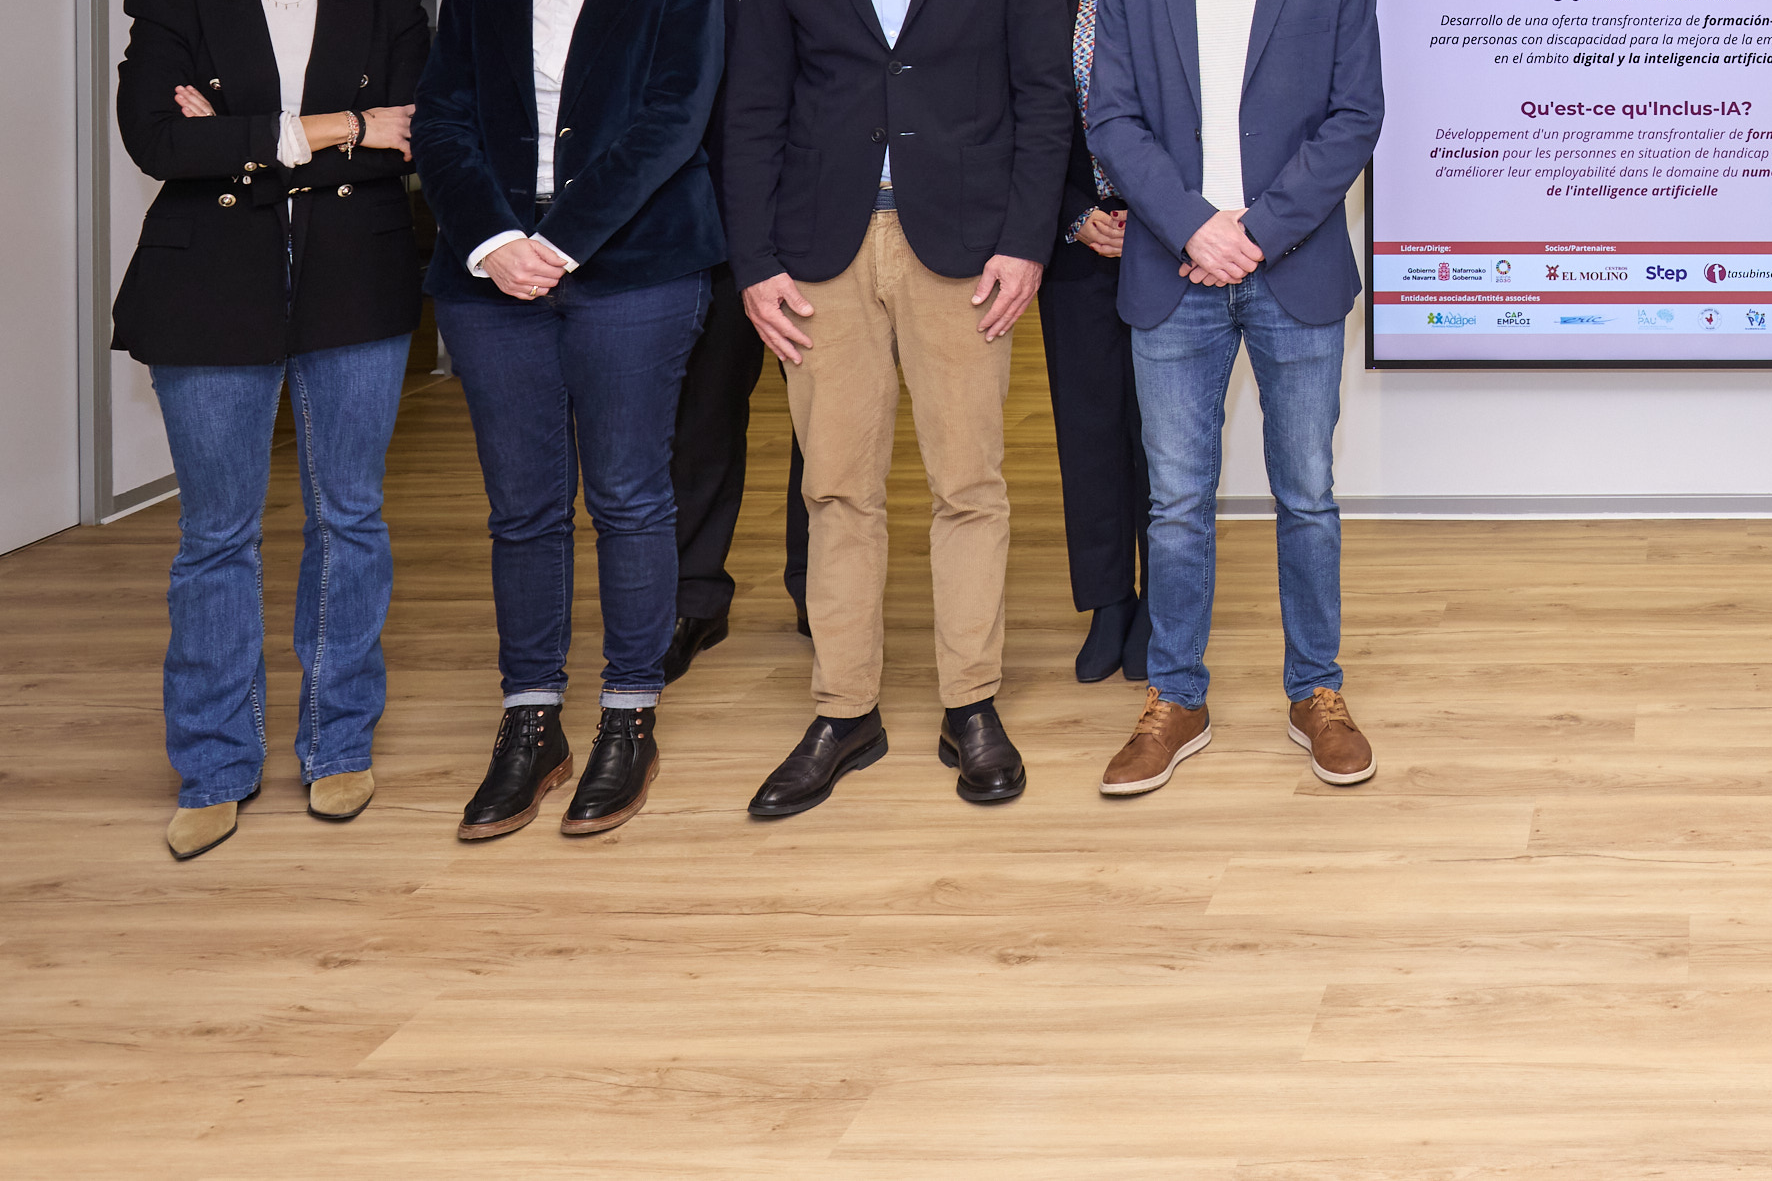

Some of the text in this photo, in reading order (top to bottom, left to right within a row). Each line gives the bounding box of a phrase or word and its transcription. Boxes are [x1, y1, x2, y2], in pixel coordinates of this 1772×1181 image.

[1441, 14, 1503, 26] Desarrollo
[1507, 15, 1521, 26] de
[1525, 17, 1548, 26] una
[1552, 14, 1588, 29] oferta
[1592, 14, 1682, 29] transfronteriza
[1686, 15, 1700, 26] de
[1429, 36, 1459, 48] para
[1462, 36, 1518, 48] personas
[1521, 36, 1543, 45] con
[1546, 34, 1627, 48] discapacidad
[1629, 36, 1659, 48] para
[1662, 34, 1673, 45] la
[1677, 34, 1720, 48] mejora
[1723, 34, 1738, 45] de
[1741, 34, 1753, 45] la
[1494, 55, 1509, 64] en
[1512, 53, 1523, 64] el
[1526, 52, 1569, 64] ámbito
[1573, 52, 1615, 67] digital
[1616, 55, 1626, 67] y
[1628, 52, 1641, 64] la
[1644, 52, 1720, 67] inteligencia
[1521, 101, 1752, 119] Qu'est-ce qu'Inclus-IA?
[1435, 128, 1529, 143] Développement
[1532, 128, 1559, 140] d'un
[1562, 131, 1634, 143] programme
[1638, 128, 1726, 143] transfrontalier
[1729, 129, 1743, 140] de
[1430, 147, 1499, 158] d'inclusion
[1502, 150, 1532, 161] pour
[1535, 147, 1551, 159] les
[1554, 150, 1616, 161] personnes
[1620, 150, 1635, 159] en
[1638, 148, 1691, 159] situation
[1695, 147, 1709, 159] de
[1713, 147, 1769, 162] handicap
[1508, 166, 1532, 177] leur
[1535, 166, 1616, 181] employabilité
[1619, 166, 1648, 177] dans
[1652, 166, 1662, 177] le
[1666, 166, 1719, 178] domaine
[1722, 166, 1738, 177] du
[1546, 185, 1718, 199] de l'intelligence artificielle
[1400, 245, 1451, 253] Lidera/Dirige:
[1562, 272, 1628, 280] EL MOLINO
[1646, 265, 1687, 282] Step
[1401, 294, 1541, 302] Entidades asociadas/Entités associées
